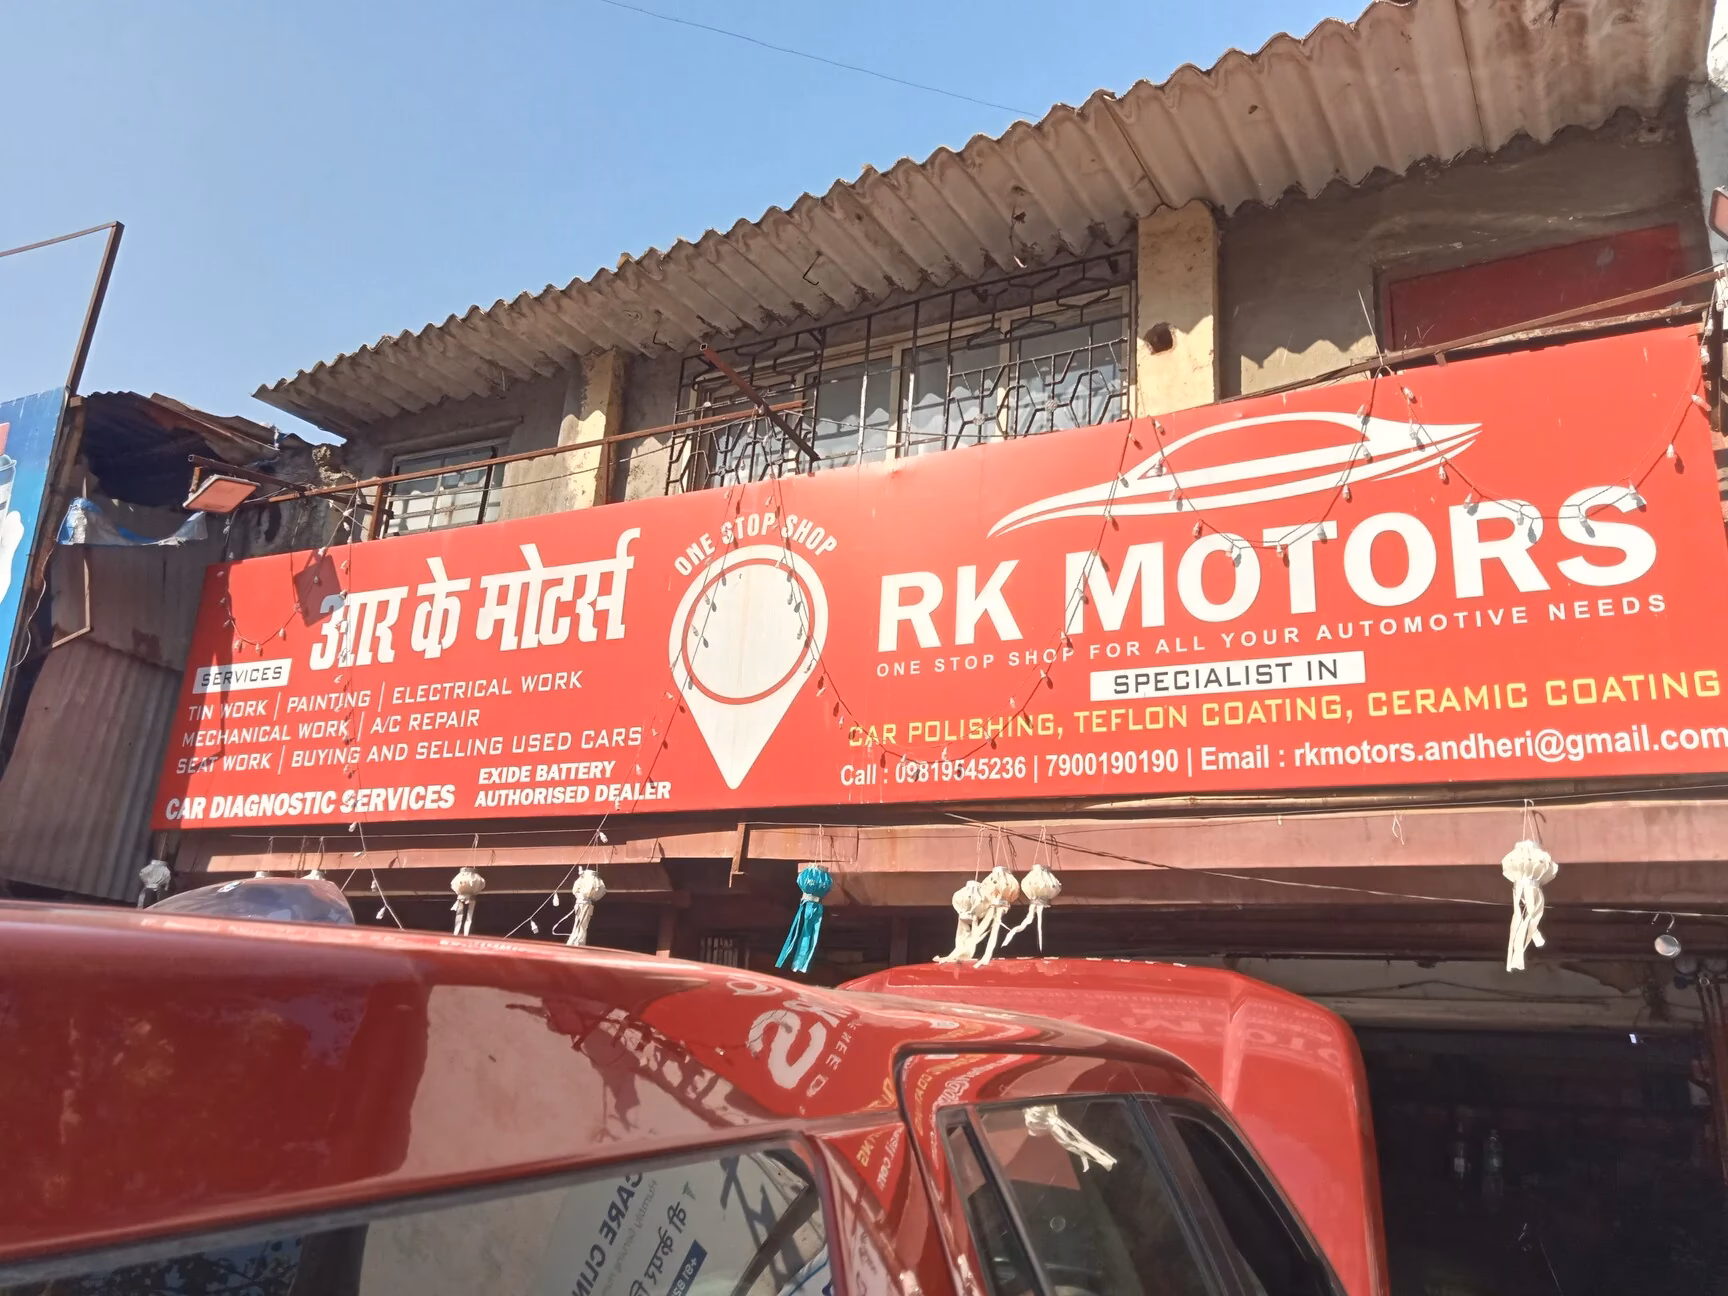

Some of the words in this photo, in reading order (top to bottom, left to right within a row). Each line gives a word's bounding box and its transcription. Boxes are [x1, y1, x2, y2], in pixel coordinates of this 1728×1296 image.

[674, 532, 716, 576] ONE
[721, 512, 777, 545] STOP
[781, 514, 838, 556] SHOP
[878, 560, 1023, 653] RK
[1065, 485, 1657, 635] MOTORS
[309, 585, 409, 671] आर
[411, 557, 471, 659] के
[475, 527, 641, 652] मोटर्स
[876, 660, 922, 677] ONE
[933, 653, 996, 673] STOP
[1008, 647, 1075, 666] SHOP
[1090, 641, 1141, 660] FOR
[1155, 635, 1206, 654] ALL
[1220, 627, 1300, 649] YOUR
[1316, 606, 1529, 642] AUTOMOTIVE
[1548, 594, 1667, 622] NEEDS
[189, 705, 213, 722] TIN
[220, 699, 268, 719] WORK
[287, 691, 371, 712] PAINTING
[392, 678, 512, 705] ELECTRICAL
[520, 670, 583, 692] WORK
[201, 665, 283, 688] SERVICES
[1113, 663, 1292, 694] SPECIALIST
[1307, 659, 1338, 681] IN
[182, 726, 291, 747] MECHANICAL
[298, 719, 349, 739] WORK
[371, 713, 401, 735] A/C
[408, 709, 480, 731] REPAIR
[849, 724, 897, 747] CAR
[1073, 704, 1188, 734] TEFLON
[1368, 682, 1528, 717] CERAMIC
[1545, 670, 1720, 707] COATING
[176, 756, 218, 774] SEAT
[222, 752, 272, 770] WORK
[291, 746, 360, 768] BUYING
[367, 741, 408, 762] AND
[416, 736, 503, 759] SELLING
[512, 731, 574, 753] USED
[581, 726, 642, 748] CARS
[478, 765, 532, 785] EXIDE
[536, 760, 616, 782] BATTERY
[840, 764, 877, 786] Call
[895, 756, 1027, 784] 09819545236
[1046, 750, 1179, 777] 7900190190
[1201, 745, 1270, 771] Email
[1295, 724, 1728, 768] rkmotors.andheri@gmail.com
[165, 798, 208, 820] CAR
[210, 789, 337, 818] DIAGNOSTIC
[339, 784, 456, 812] SERVICES
[474, 786, 596, 808] AUTHORISED
[600, 781, 671, 803] DEALER
